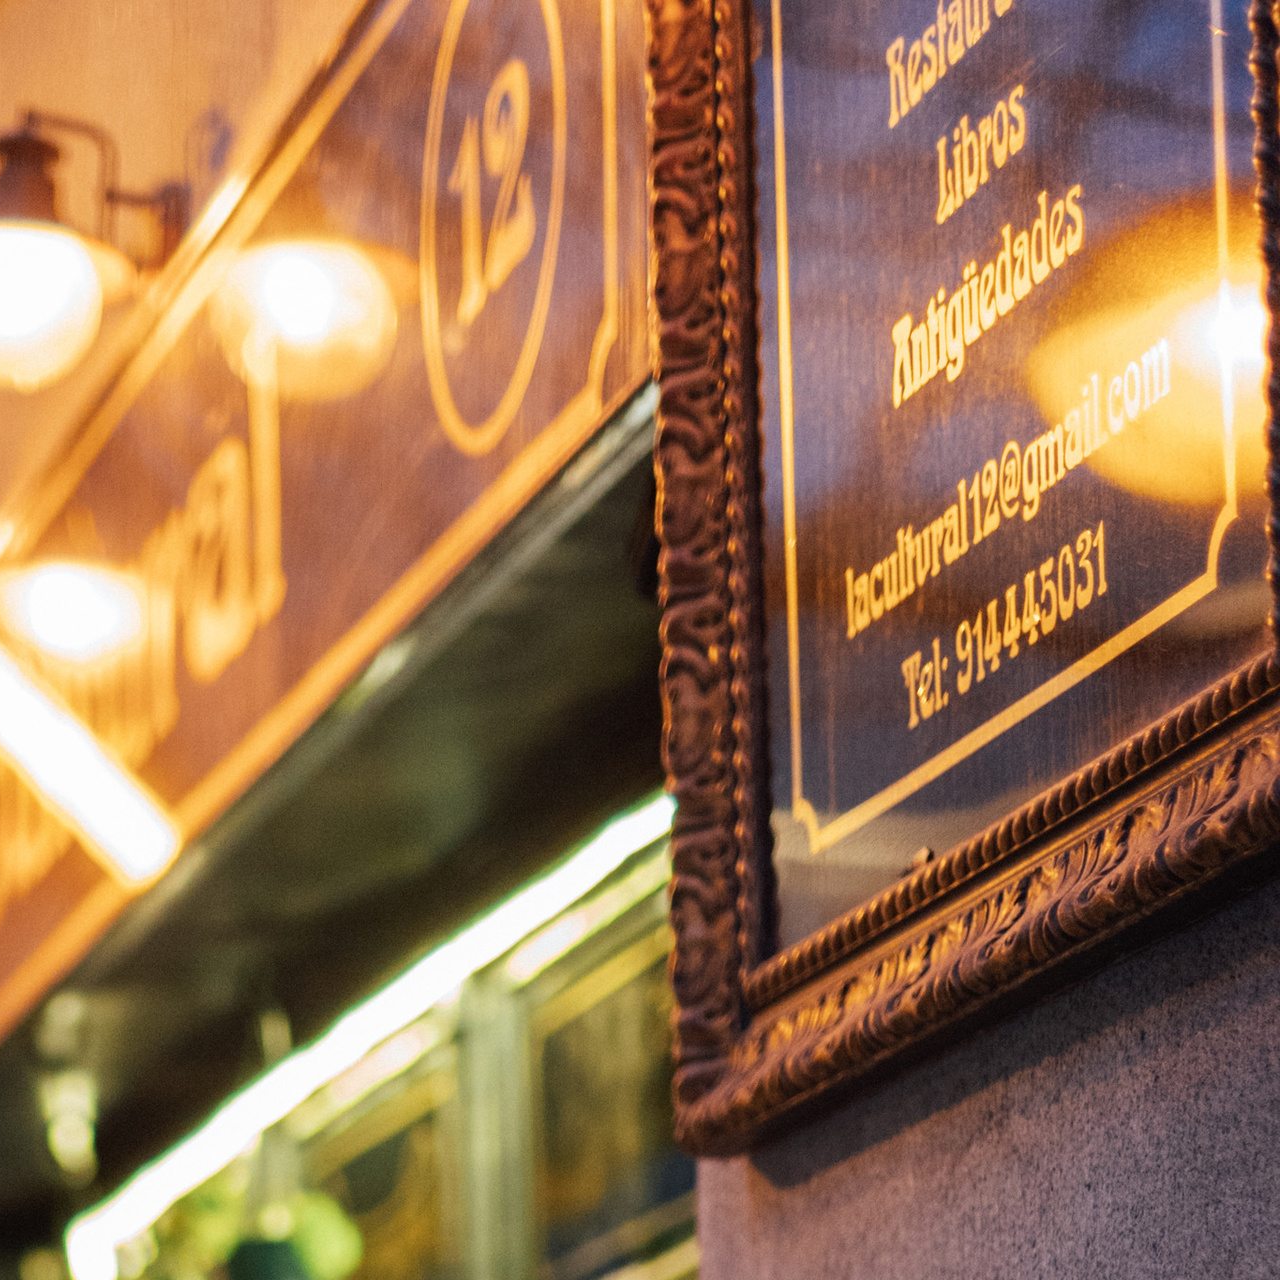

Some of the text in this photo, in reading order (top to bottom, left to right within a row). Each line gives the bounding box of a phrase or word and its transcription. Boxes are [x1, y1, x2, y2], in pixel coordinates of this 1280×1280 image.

[886, 0, 1014, 129] Restau
[936, 84, 1026, 225] Libros
[447, 57, 537, 323] 12
[891, 183, 1084, 409] Antigüedades
[845, 337, 1171, 640] lacultural12@gmail.com
[901, 520, 1108, 730] Tel: 914445031
